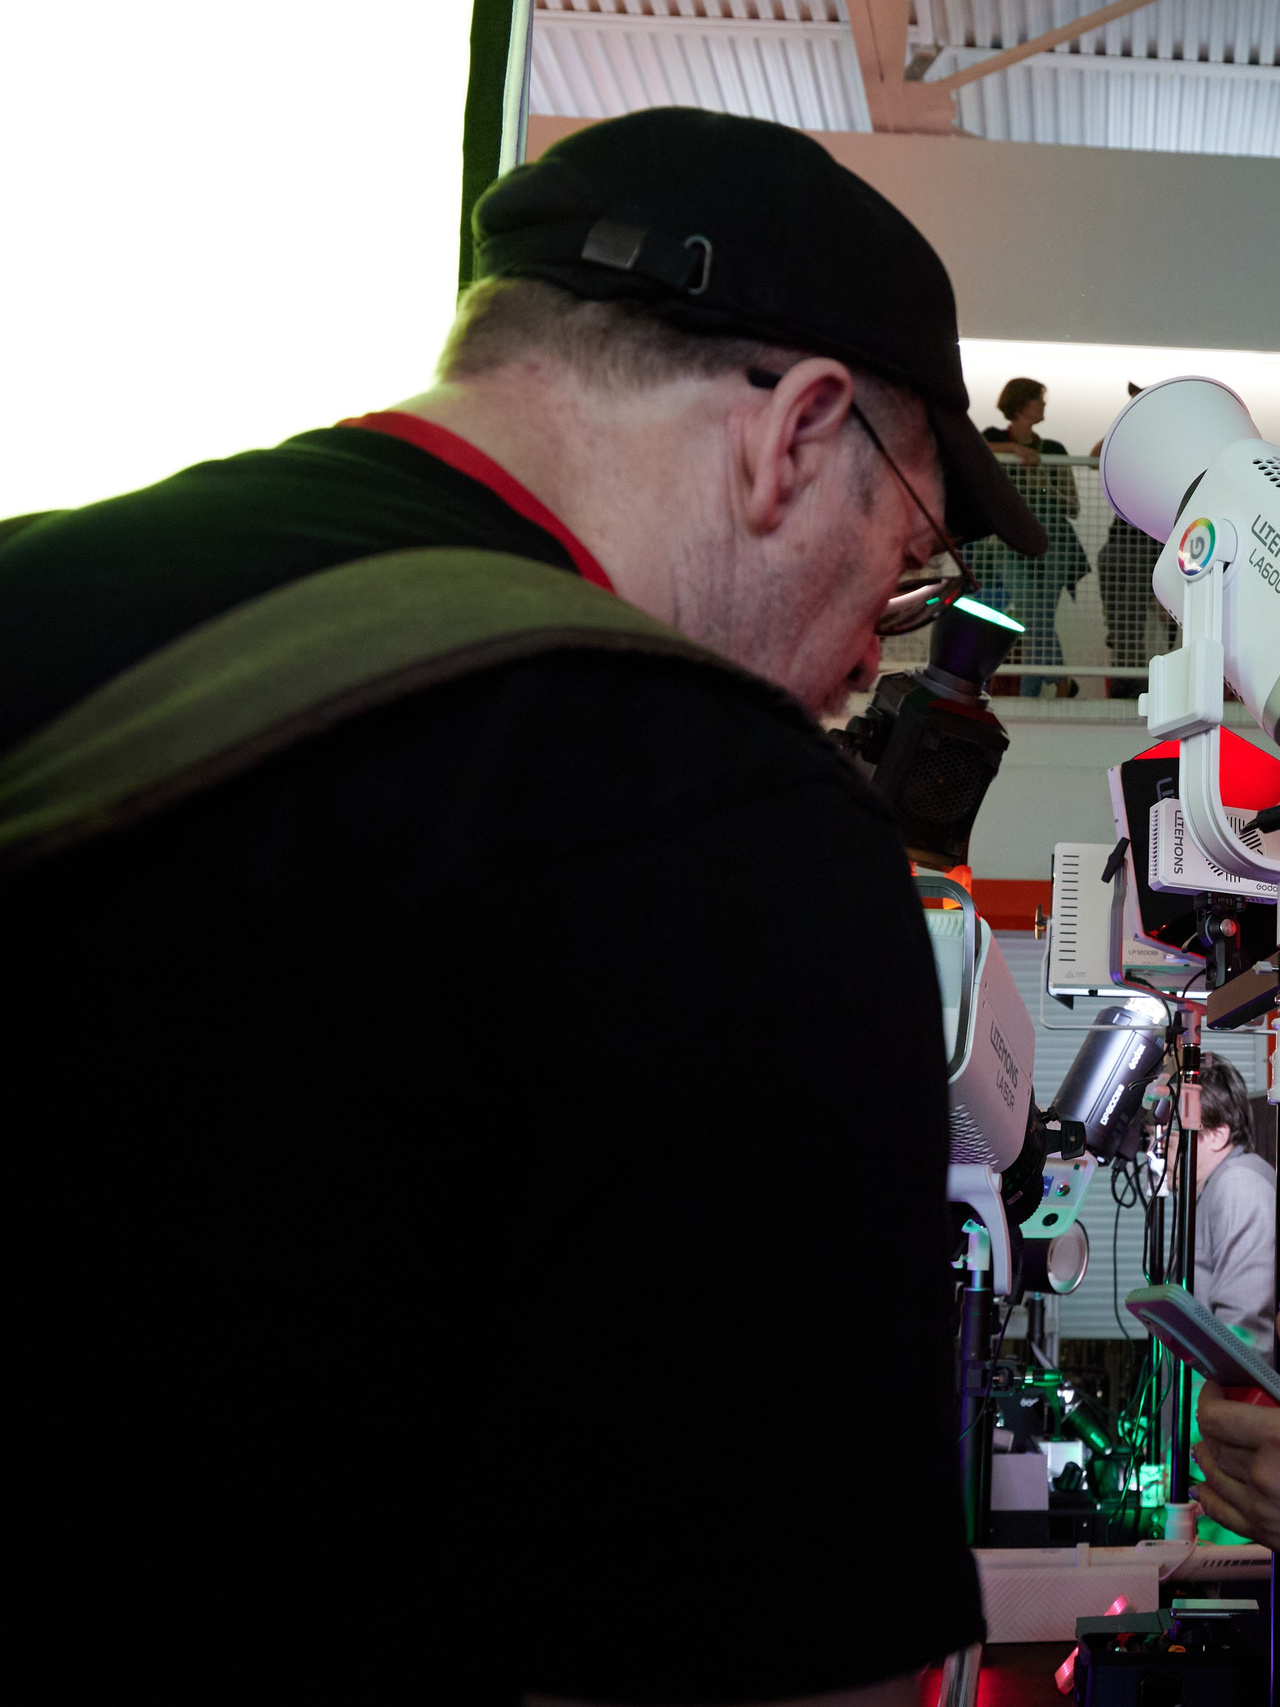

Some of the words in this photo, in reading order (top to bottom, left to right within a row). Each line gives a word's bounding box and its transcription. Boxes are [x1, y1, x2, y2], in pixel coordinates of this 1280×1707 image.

[1174, 809, 1184, 875] LITEMONS
[1256, 883, 1279, 892] Godo
[990, 1021, 1019, 1089] LITEMONS
